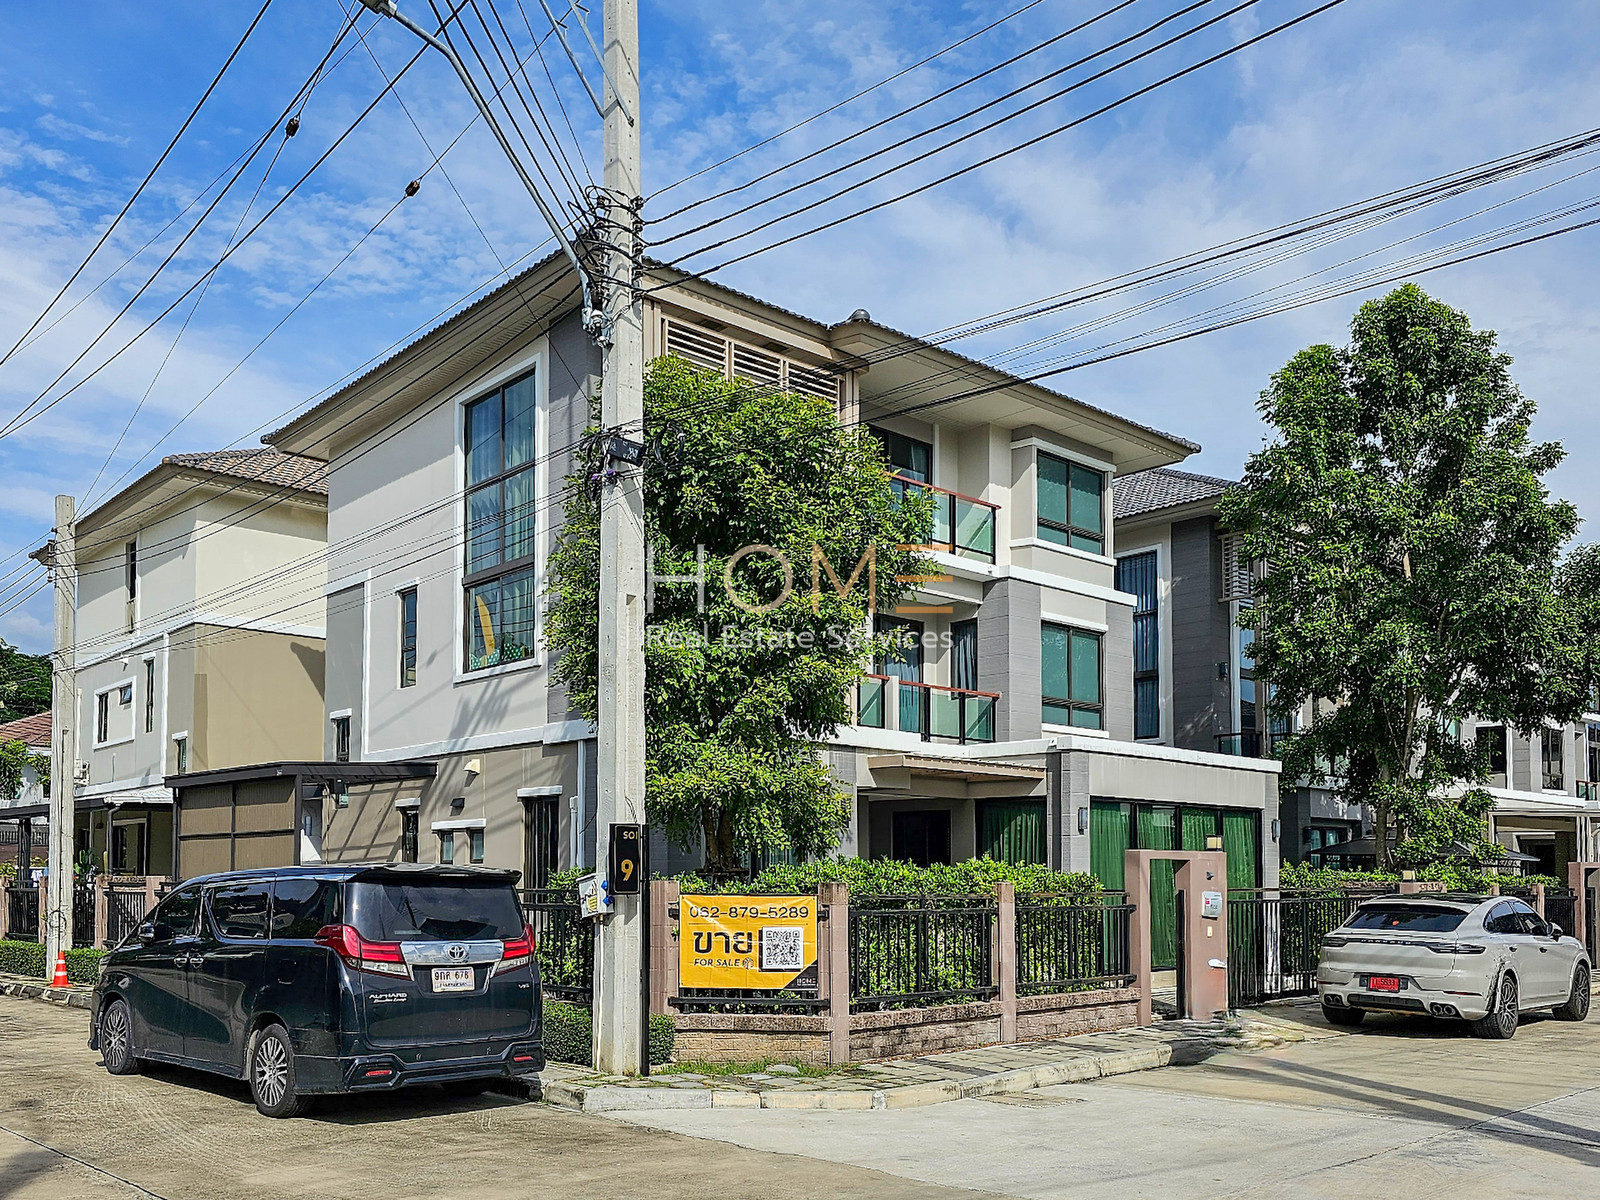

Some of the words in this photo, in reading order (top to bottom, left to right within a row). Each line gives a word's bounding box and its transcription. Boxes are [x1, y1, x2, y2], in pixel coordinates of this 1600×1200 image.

[623, 831, 638, 840] SOI
[621, 859, 633, 881] 9
[689, 906, 809, 918] 062-879-5289
[693, 931, 753, 954] ขาย
[694, 958, 713, 966] FOR
[716, 958, 740, 966] SALE
